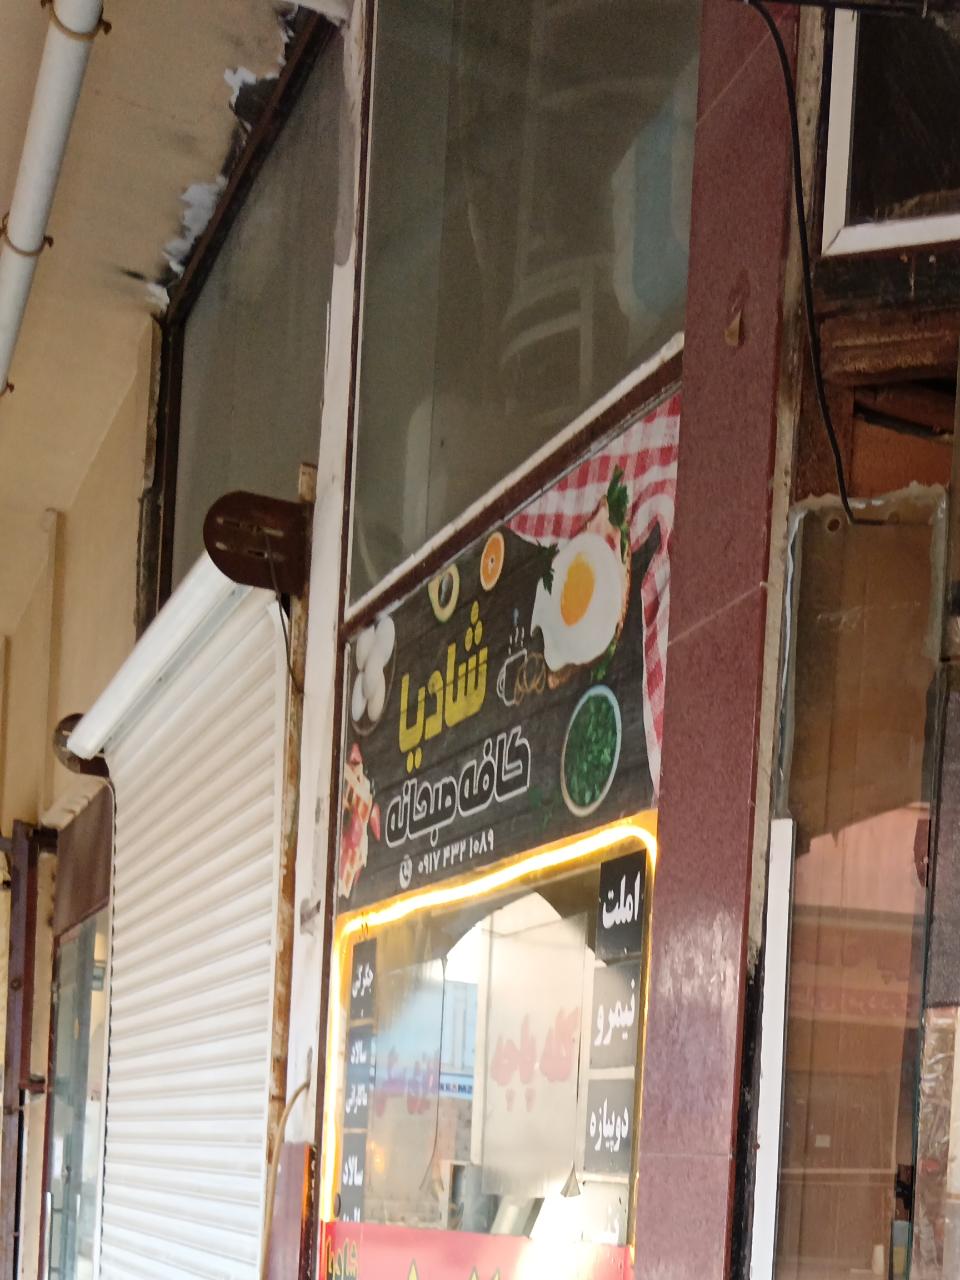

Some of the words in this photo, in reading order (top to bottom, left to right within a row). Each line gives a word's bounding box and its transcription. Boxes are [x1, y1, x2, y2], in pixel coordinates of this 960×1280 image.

[399, 600, 488, 773] شادیا
[458, 725, 531, 817] کافه
[385, 775, 457, 848] صبحانه
[602, 870, 640, 929] املت
[594, 978, 636, 1046] نیمرو
[589, 1098, 629, 1152] دوپیازه
[342, 1154, 363, 1187] سالاد
